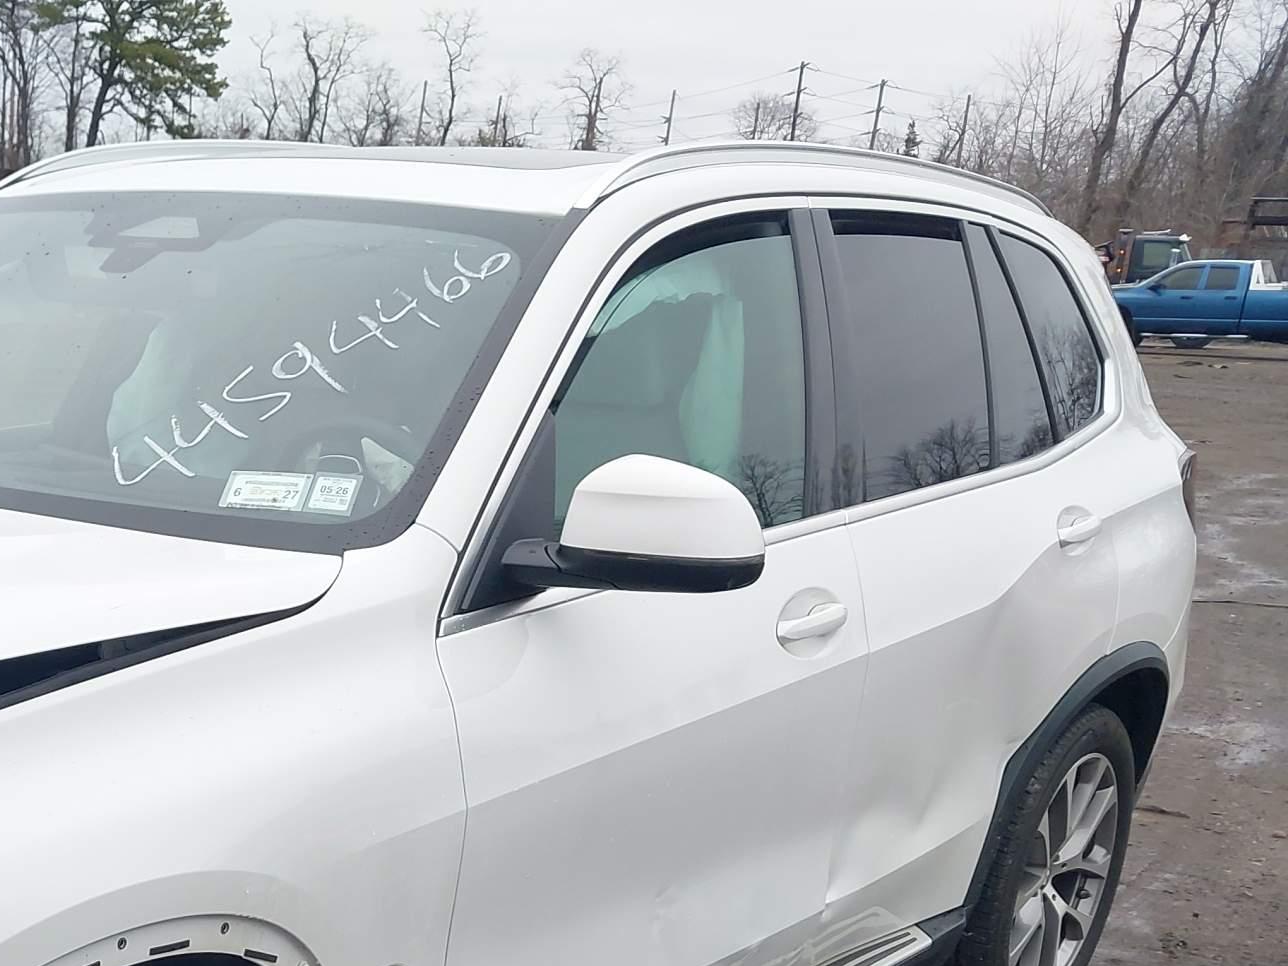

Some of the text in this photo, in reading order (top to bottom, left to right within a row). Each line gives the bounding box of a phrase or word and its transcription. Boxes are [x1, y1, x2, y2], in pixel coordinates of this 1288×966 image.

[112, 249, 511, 486] 44594466
[233, 487, 299, 500] 6 27
